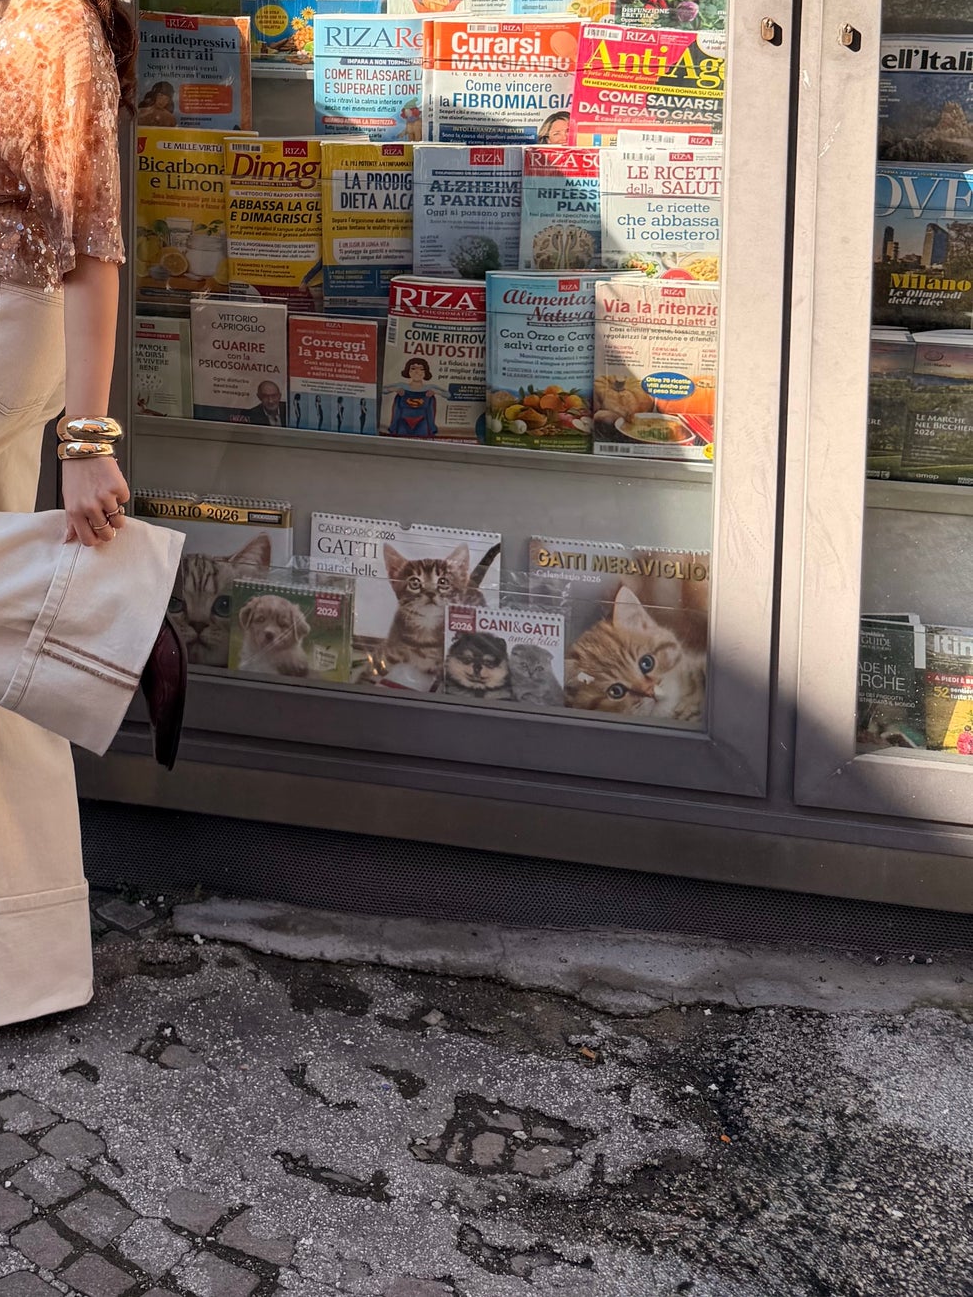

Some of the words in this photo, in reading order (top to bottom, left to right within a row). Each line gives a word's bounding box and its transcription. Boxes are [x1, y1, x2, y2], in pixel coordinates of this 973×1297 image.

[151, 31, 236, 50] antidepressivi
[324, 26, 394, 47] RIZA
[451, 32, 541, 54] Curarsi
[626, 31, 656, 42] RIZA
[151, 46, 214, 61] naturali
[324, 68, 353, 80] COME
[356, 69, 412, 81] RILASSARE
[334, 83, 386, 95] SUPERARE
[465, 79, 499, 92] Come
[502, 80, 552, 93] vincere
[599, 90, 644, 105] COME
[646, 94, 719, 111] SALVARSI
[579, 102, 609, 115] DAL
[610, 104, 669, 119] FEGATO
[671, 106, 723, 122] GRASS
[627, 166, 649, 180] LE
[344, 172, 364, 190] LA
[627, 183, 655, 195] della
[661, 180, 722, 195] SALUT
[230, 199, 285, 212] ABBASSA
[287, 200, 303, 211] LA
[341, 192, 377, 210] DIETA
[647, 203, 664, 214] Le
[667, 202, 710, 214] ricette
[241, 212, 313, 224] DIMAGRISCI
[617, 214, 646, 227] che
[651, 214, 719, 227] abbassa
[640, 228, 720, 241] colesterol
[890, 273, 972, 292] Milano
[391, 286, 478, 314] RIZA
[603, 299, 630, 314] Via
[636, 300, 652, 314] la
[218, 313, 258, 324] VITTORIO
[211, 322, 266, 333] CAPRIOGLIO
[404, 329, 440, 342] COME
[500, 329, 524, 339] Con
[527, 329, 556, 341] Orzo
[212, 339, 266, 353] GUARIRE
[301, 335, 367, 352] Correggi
[504, 340, 533, 351] salvi
[315, 349, 370, 362] postura
[198, 358, 281, 374] PSICOSOMATICA
[927, 414, 966, 424] MARCHE
[914, 428, 935, 436] 2026
[207, 507, 239, 521] 2026
[376, 529, 396, 541] 2026
[317, 536, 379, 560] GATTI
[537, 549, 587, 570] GATTI
[317, 561, 378, 577] marachelle
[479, 618, 561, 637] CANI&GATTI
[933, 686, 950, 698] 52
